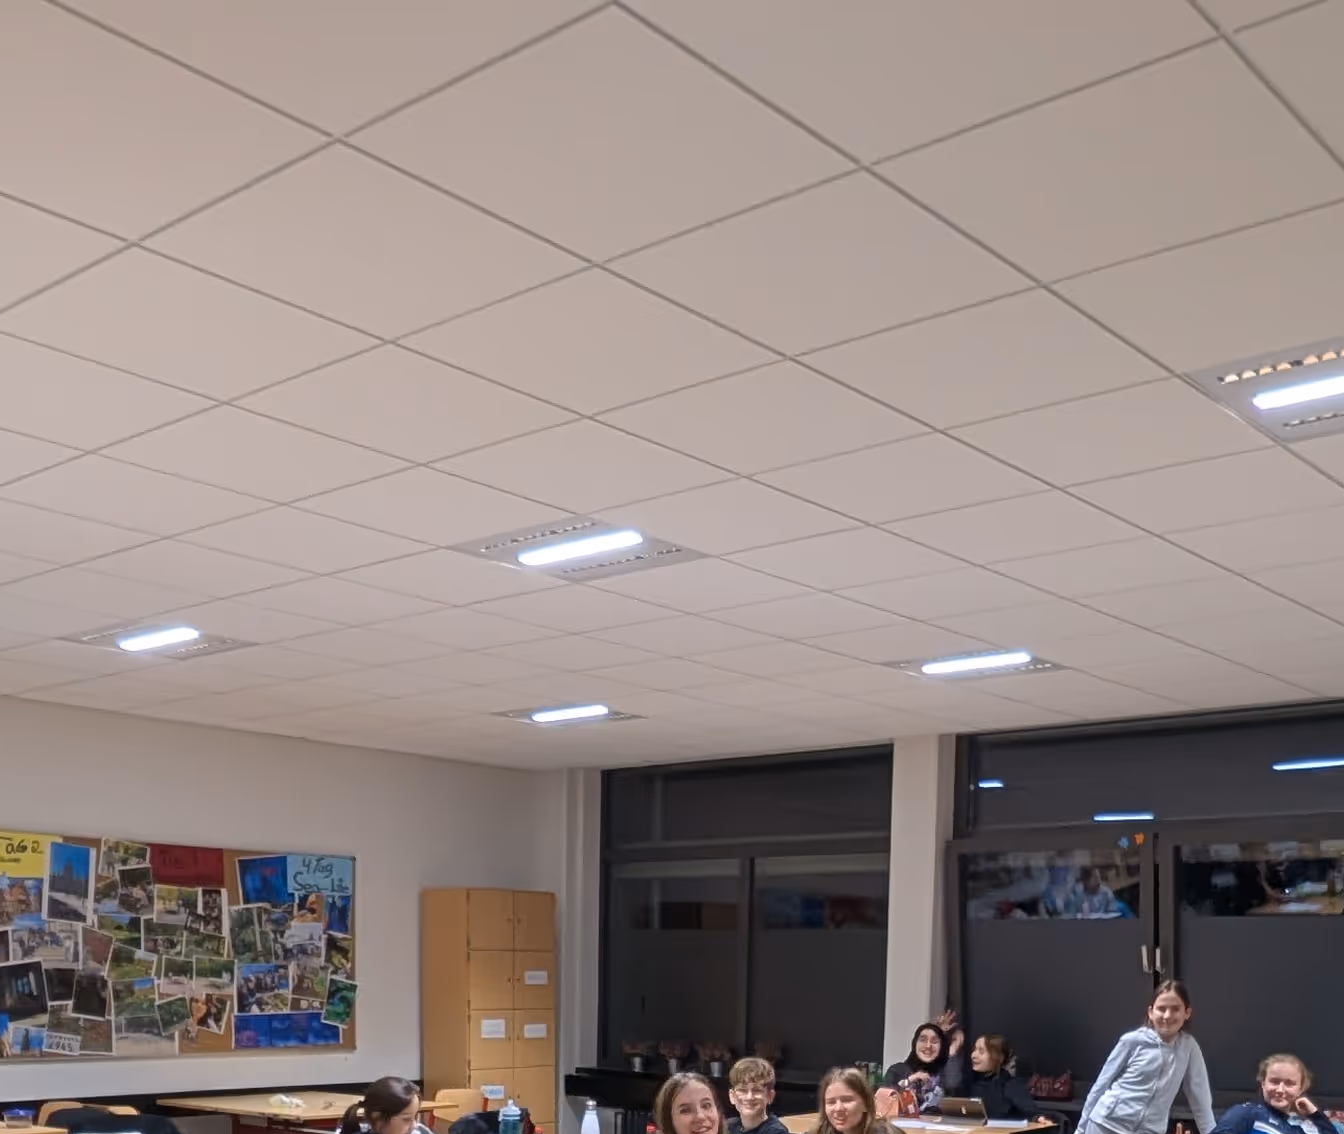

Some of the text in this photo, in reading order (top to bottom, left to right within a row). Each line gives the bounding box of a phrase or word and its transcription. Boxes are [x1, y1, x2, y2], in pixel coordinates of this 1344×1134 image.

[30, 840, 45, 855] 2
[302, 857, 334, 880] 4 Tag
